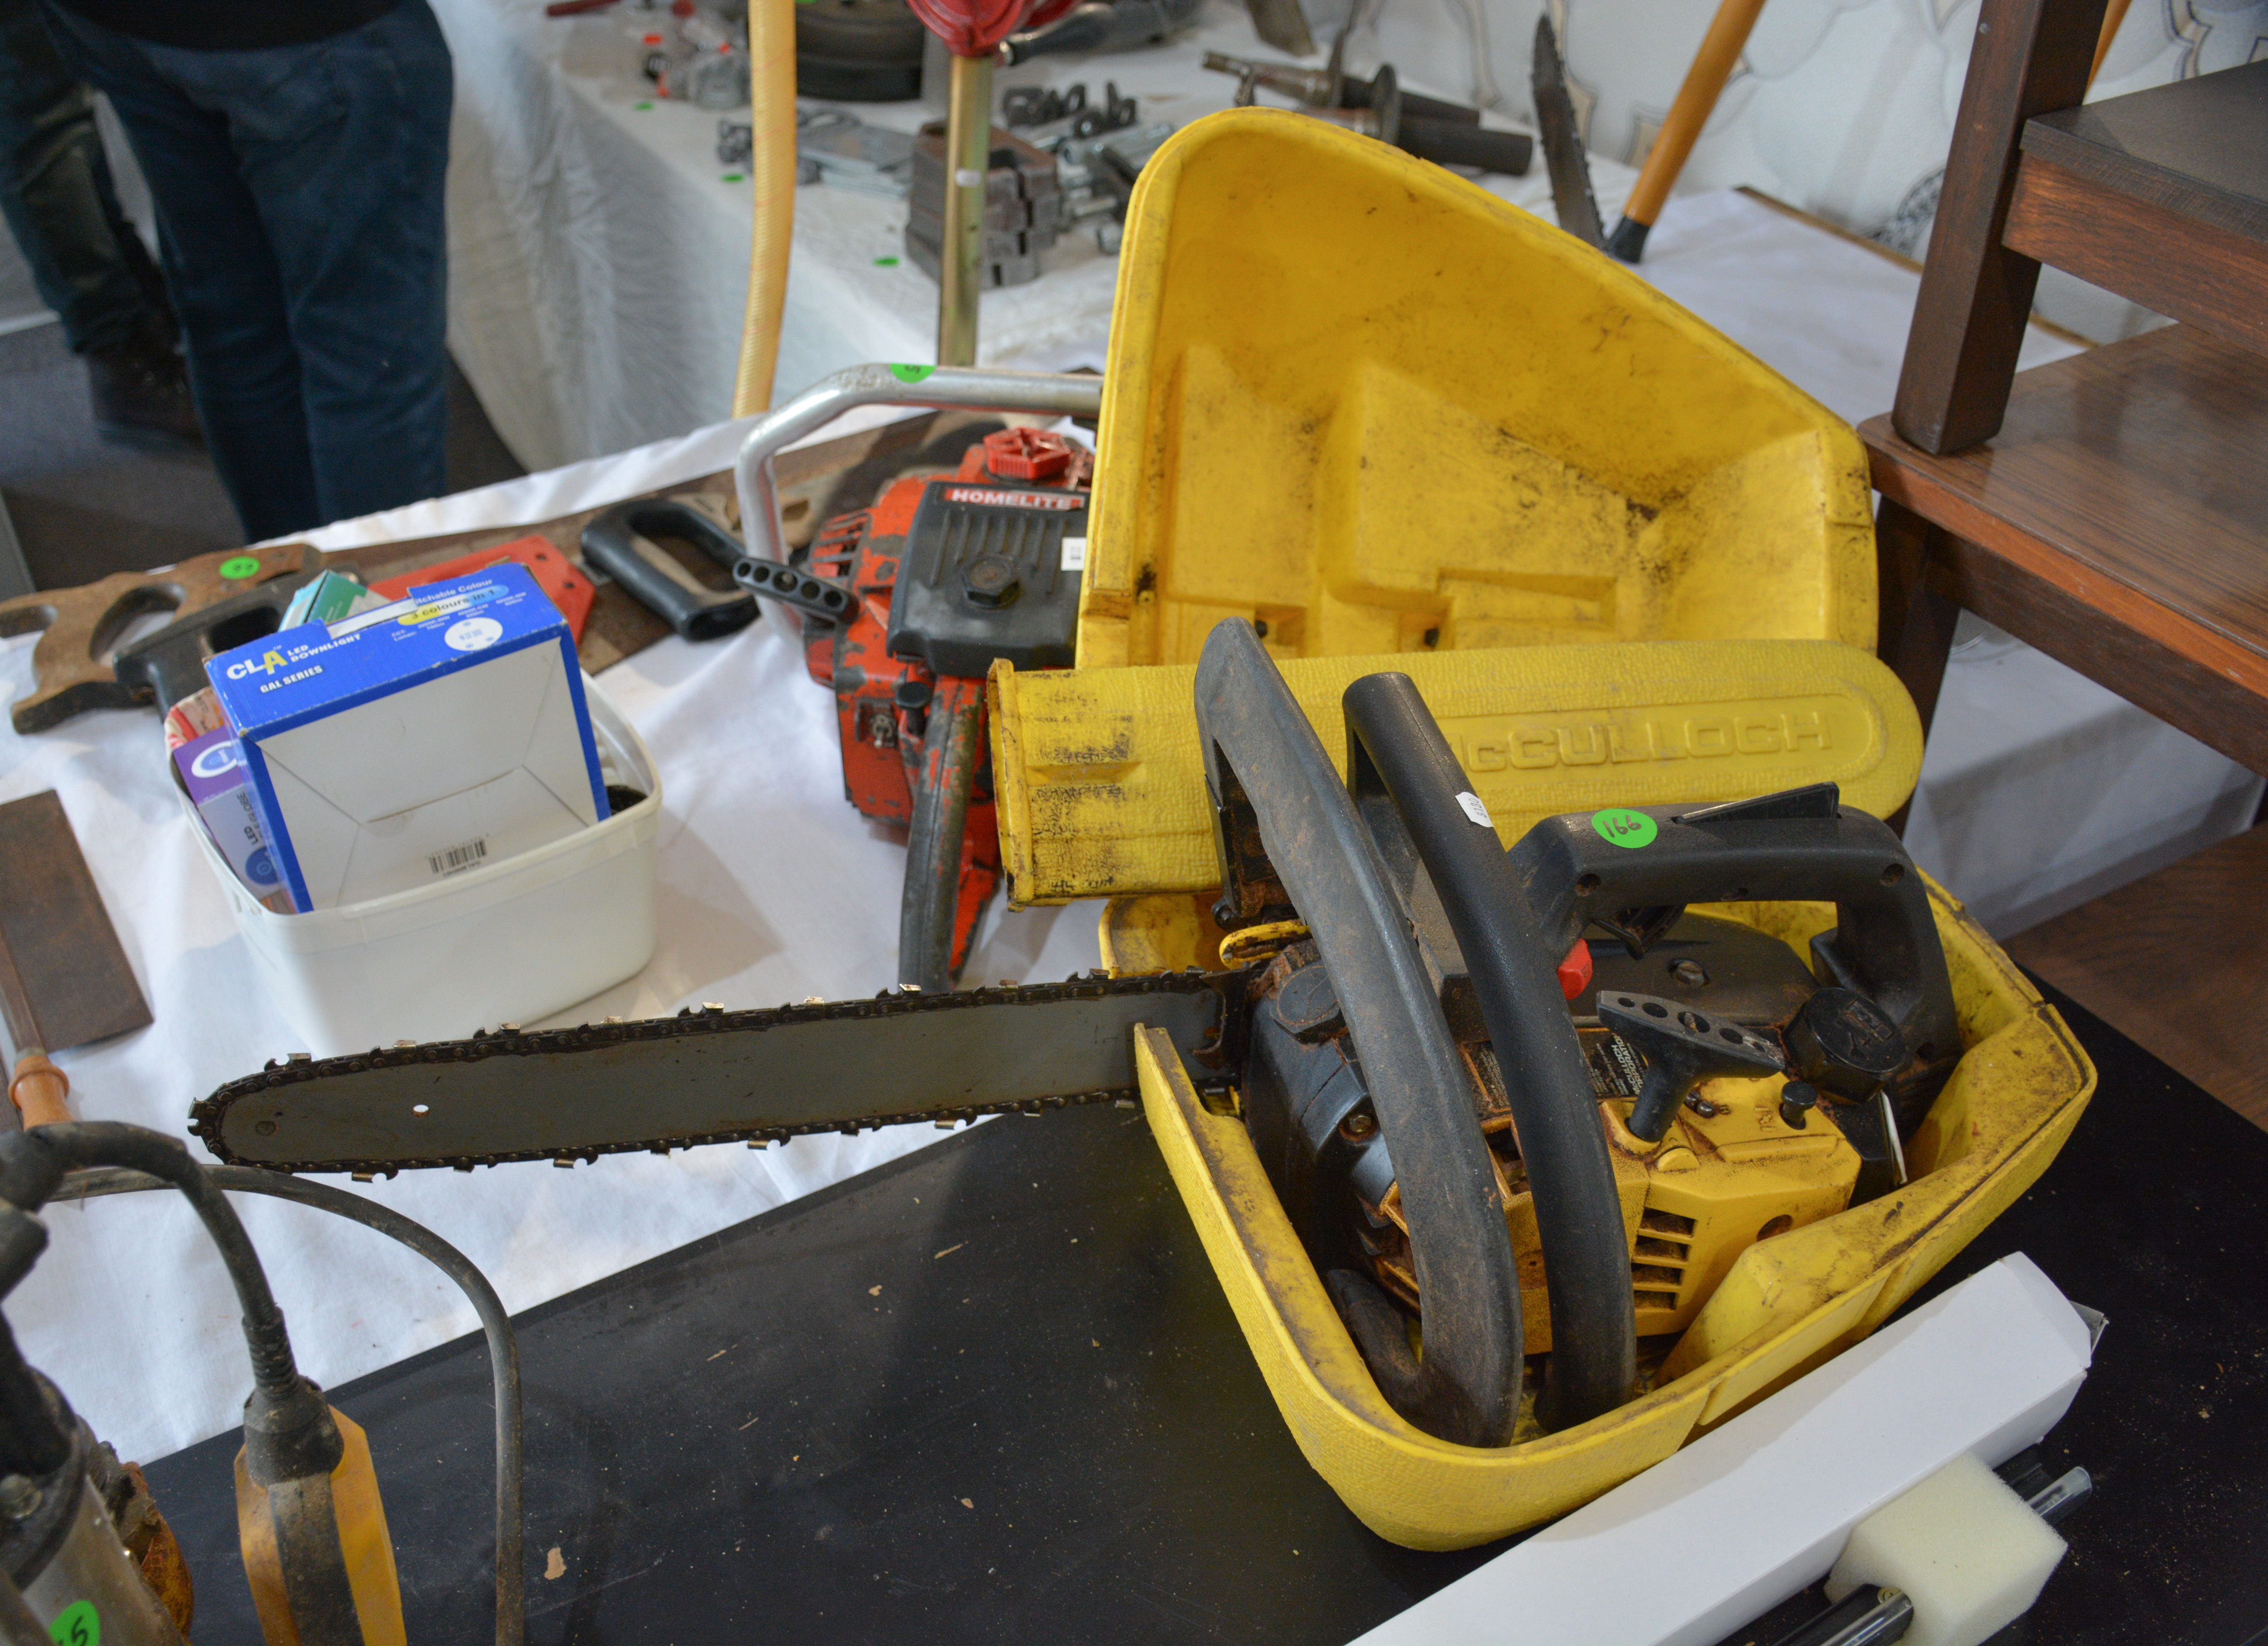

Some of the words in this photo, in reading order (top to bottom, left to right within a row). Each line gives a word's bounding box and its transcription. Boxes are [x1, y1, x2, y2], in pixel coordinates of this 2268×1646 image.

[951, 489, 1071, 509] HOMELITE
[422, 597, 470, 616] colours
[473, 592, 485, 600] in
[287, 644, 309, 656] LED
[290, 634, 361, 663] DOWNLIGHT
[227, 650, 288, 680] CLA
[283, 665, 323, 686] SERIES
[1603, 815, 1642, 838] 166
